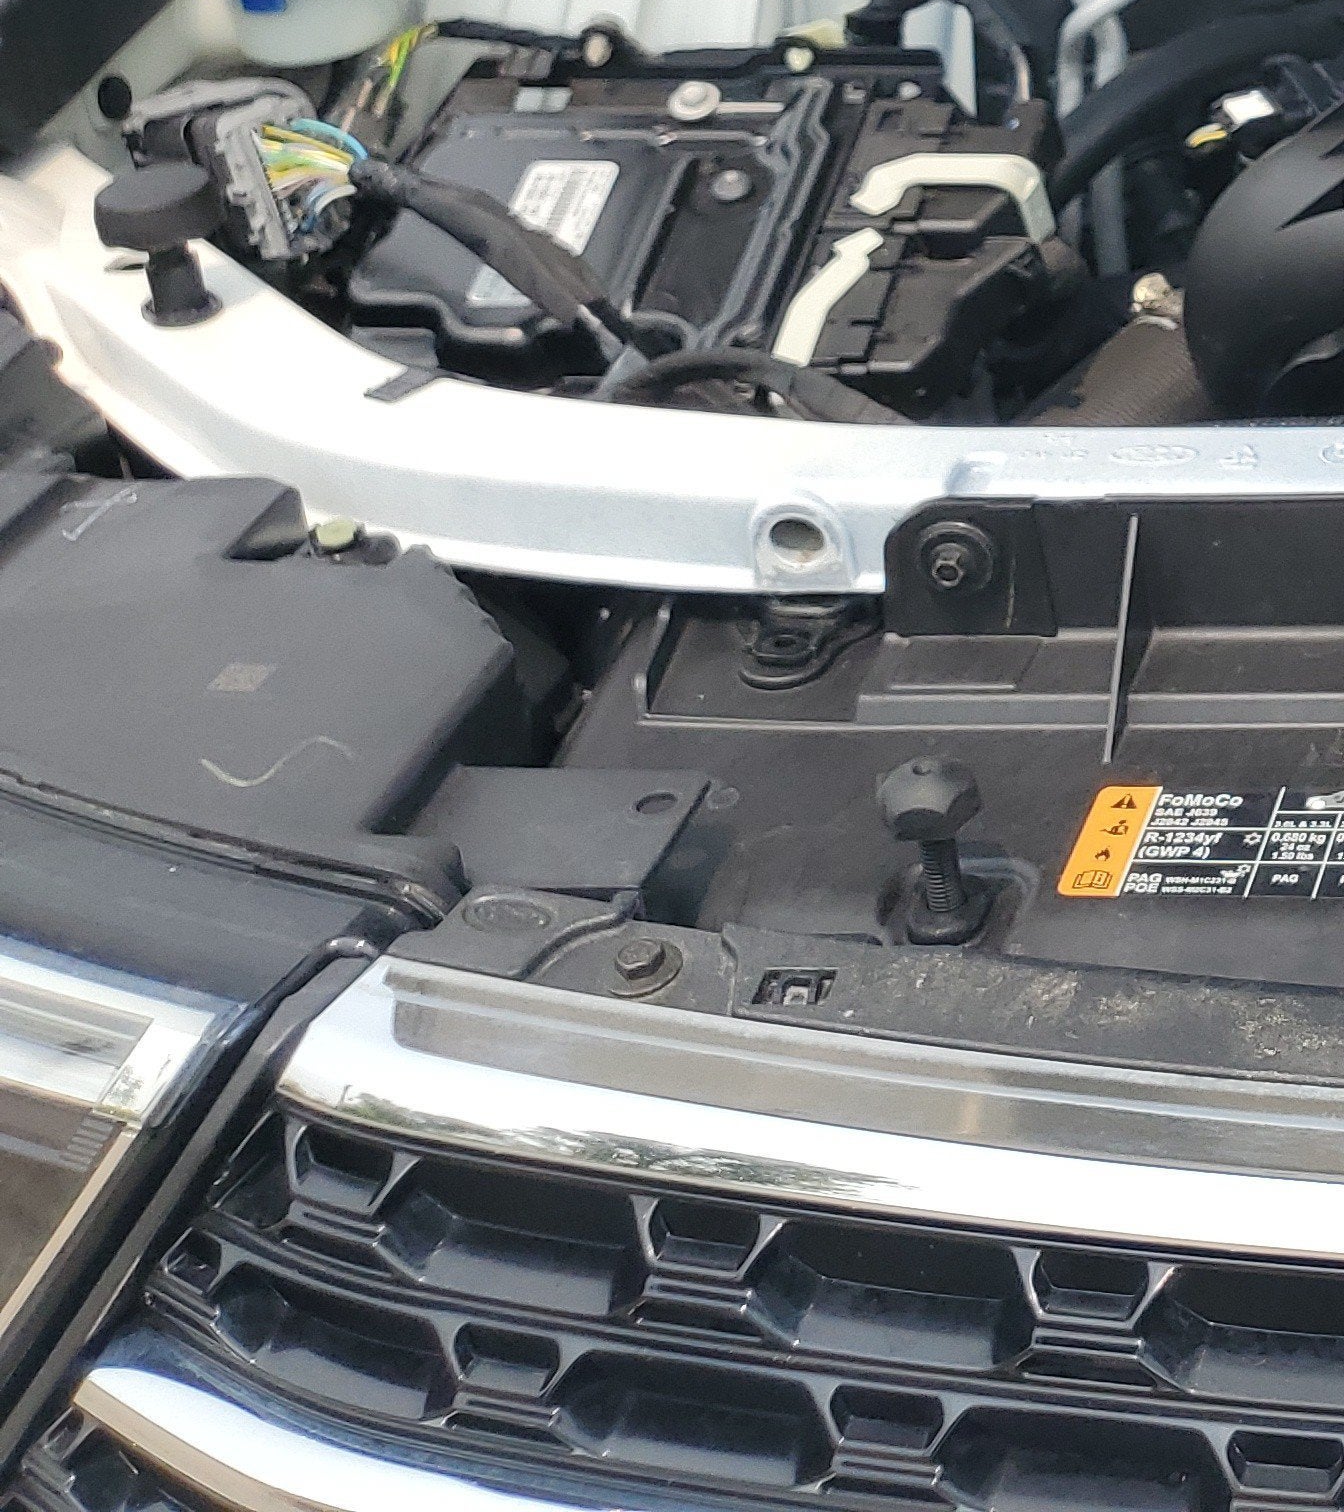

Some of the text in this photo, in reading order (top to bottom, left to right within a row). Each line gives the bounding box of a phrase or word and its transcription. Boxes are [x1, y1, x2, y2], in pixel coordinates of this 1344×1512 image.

[1157, 793, 1244, 808] FoMoCo
[1154, 808, 1184, 817] SAE
[1143, 832, 1223, 845] R-1234yf
[1308, 833, 1327, 845] kg
[1138, 846, 1211, 859] (GWP 4)
[1127, 873, 1162, 883] PAG
[1271, 874, 1299, 883] PAG
[1123, 883, 1161, 893] POE
